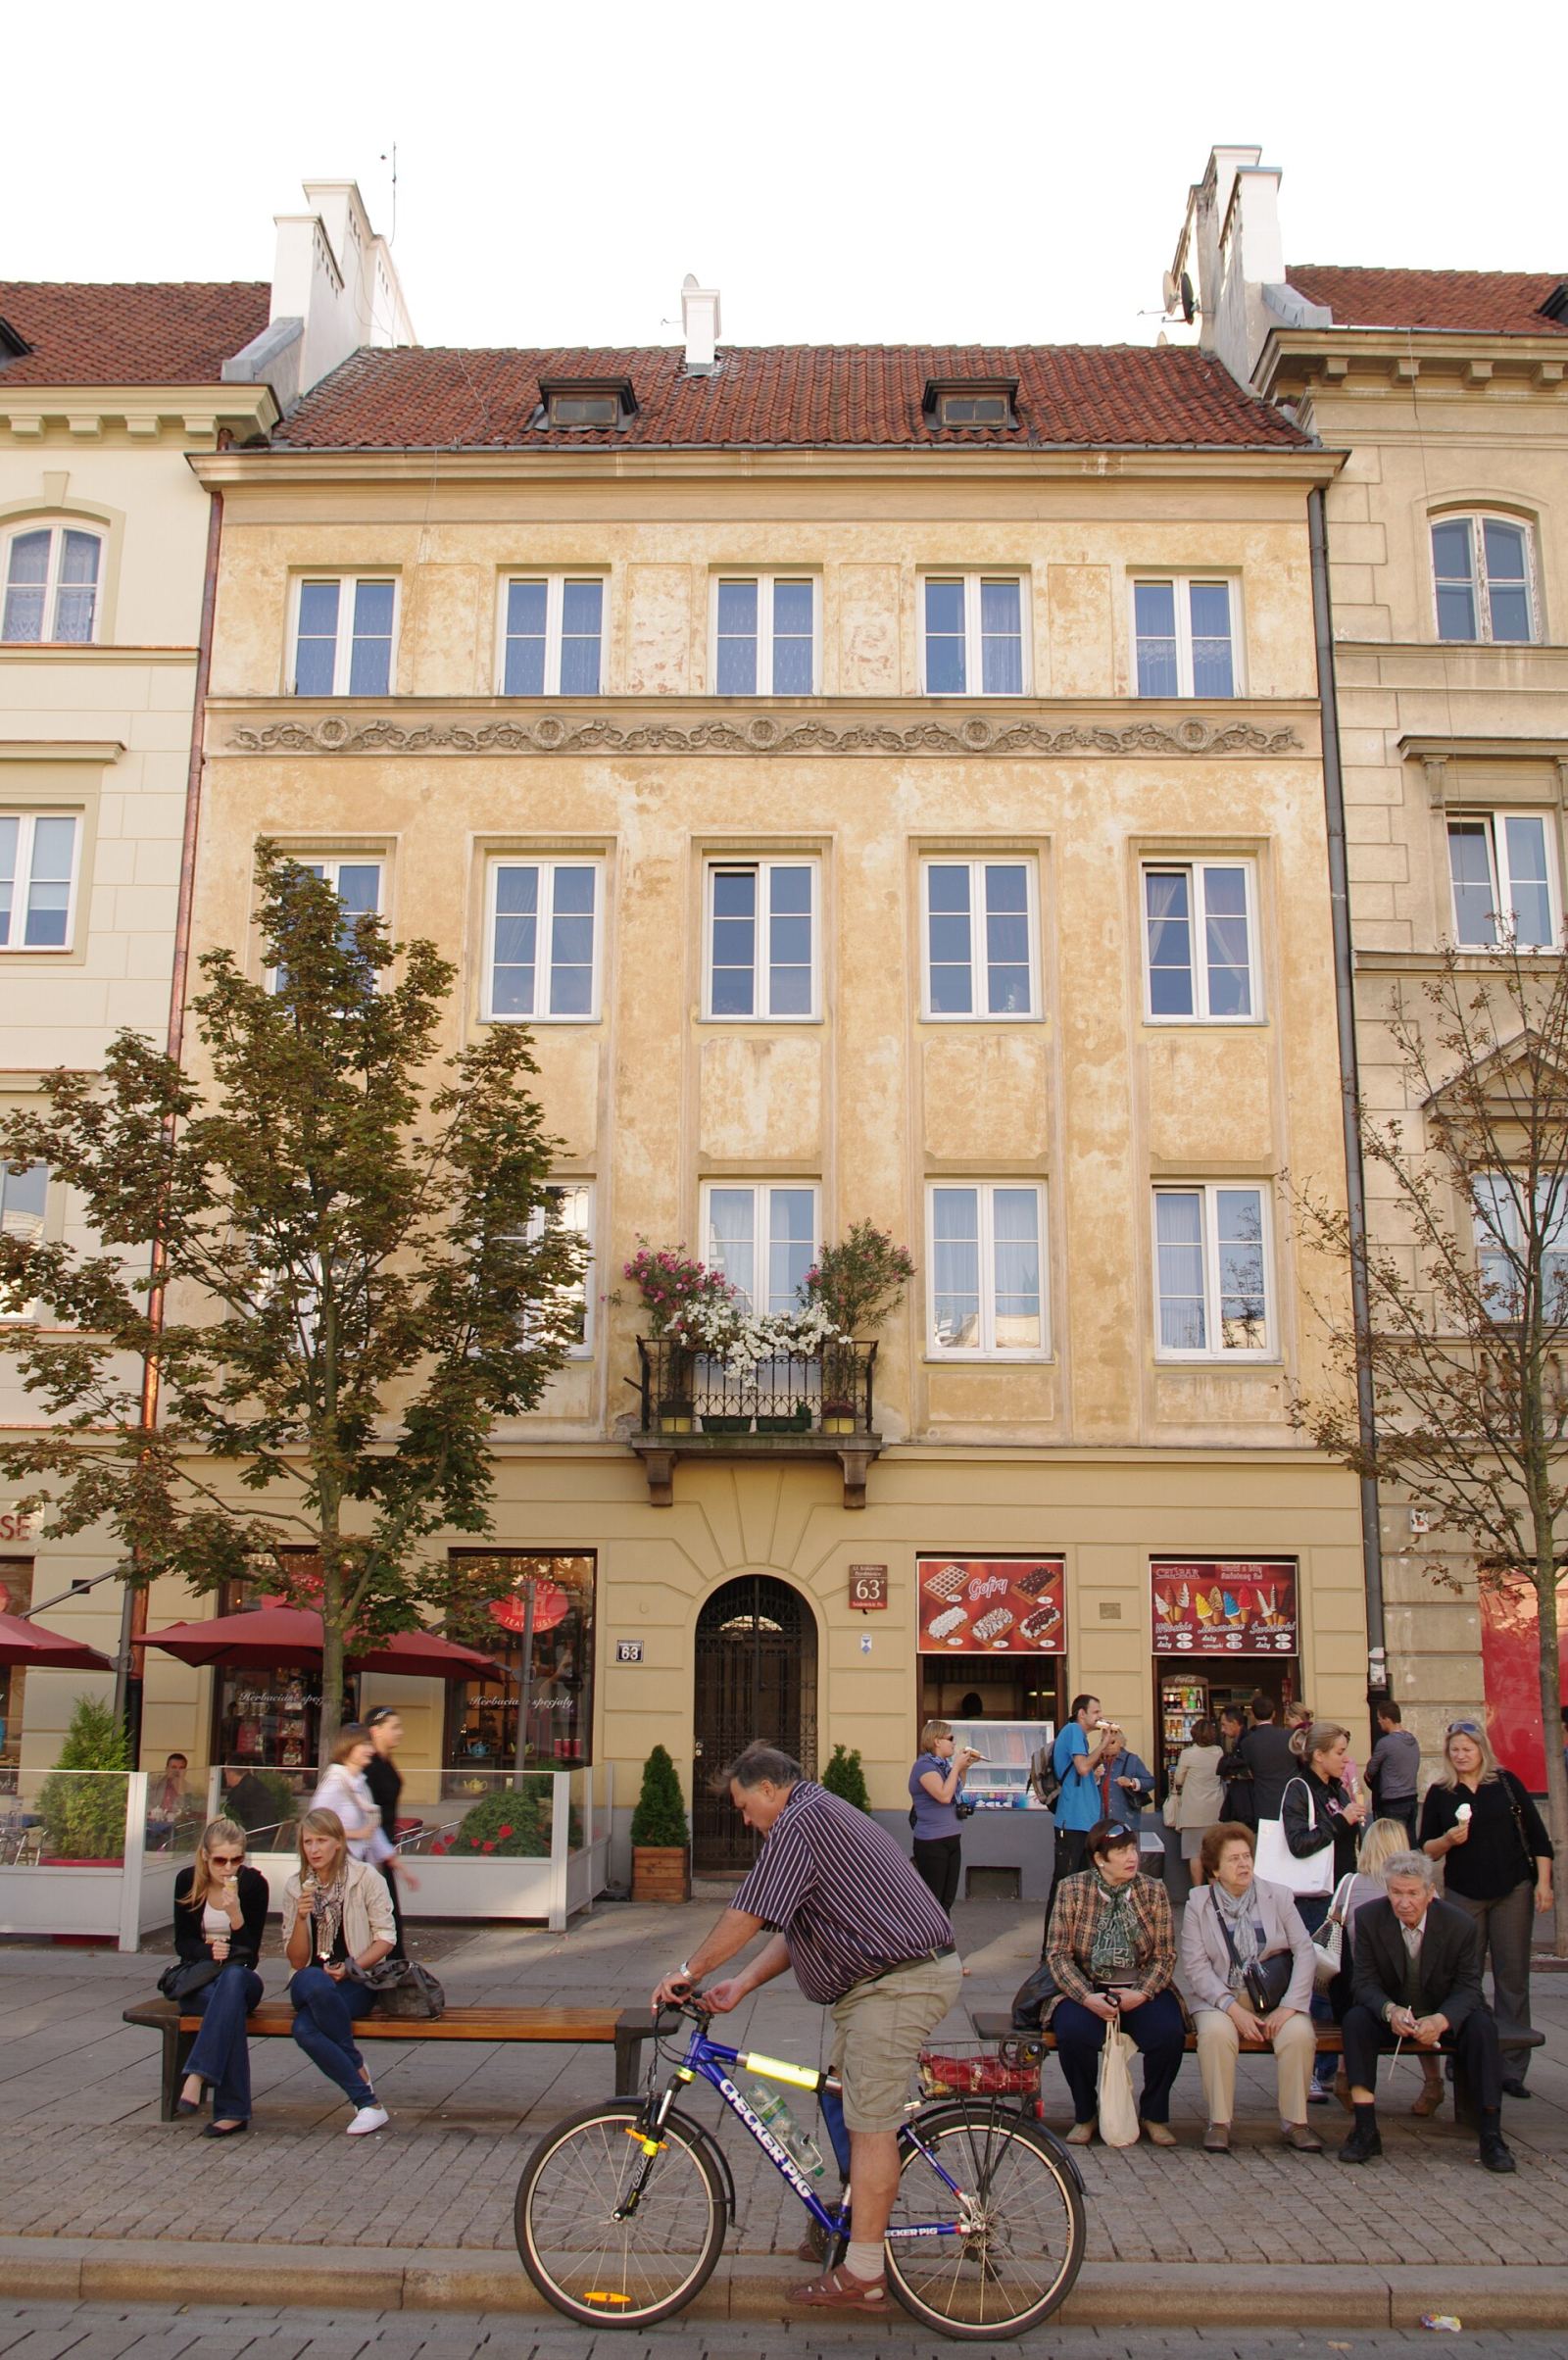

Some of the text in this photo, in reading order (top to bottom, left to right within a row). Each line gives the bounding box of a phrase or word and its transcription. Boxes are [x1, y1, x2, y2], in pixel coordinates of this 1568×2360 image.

[856, 1579, 881, 1599] 63
[968, 1576, 1008, 1600] Gofry
[505, 1616, 553, 1628] TEAUSE
[621, 1646, 639, 1660] 63
[469, 1695, 573, 1709] Herbacia specjały
[719, 2078, 815, 2197] CHECKER PIG
[884, 2228, 938, 2237] ECKER PIG
